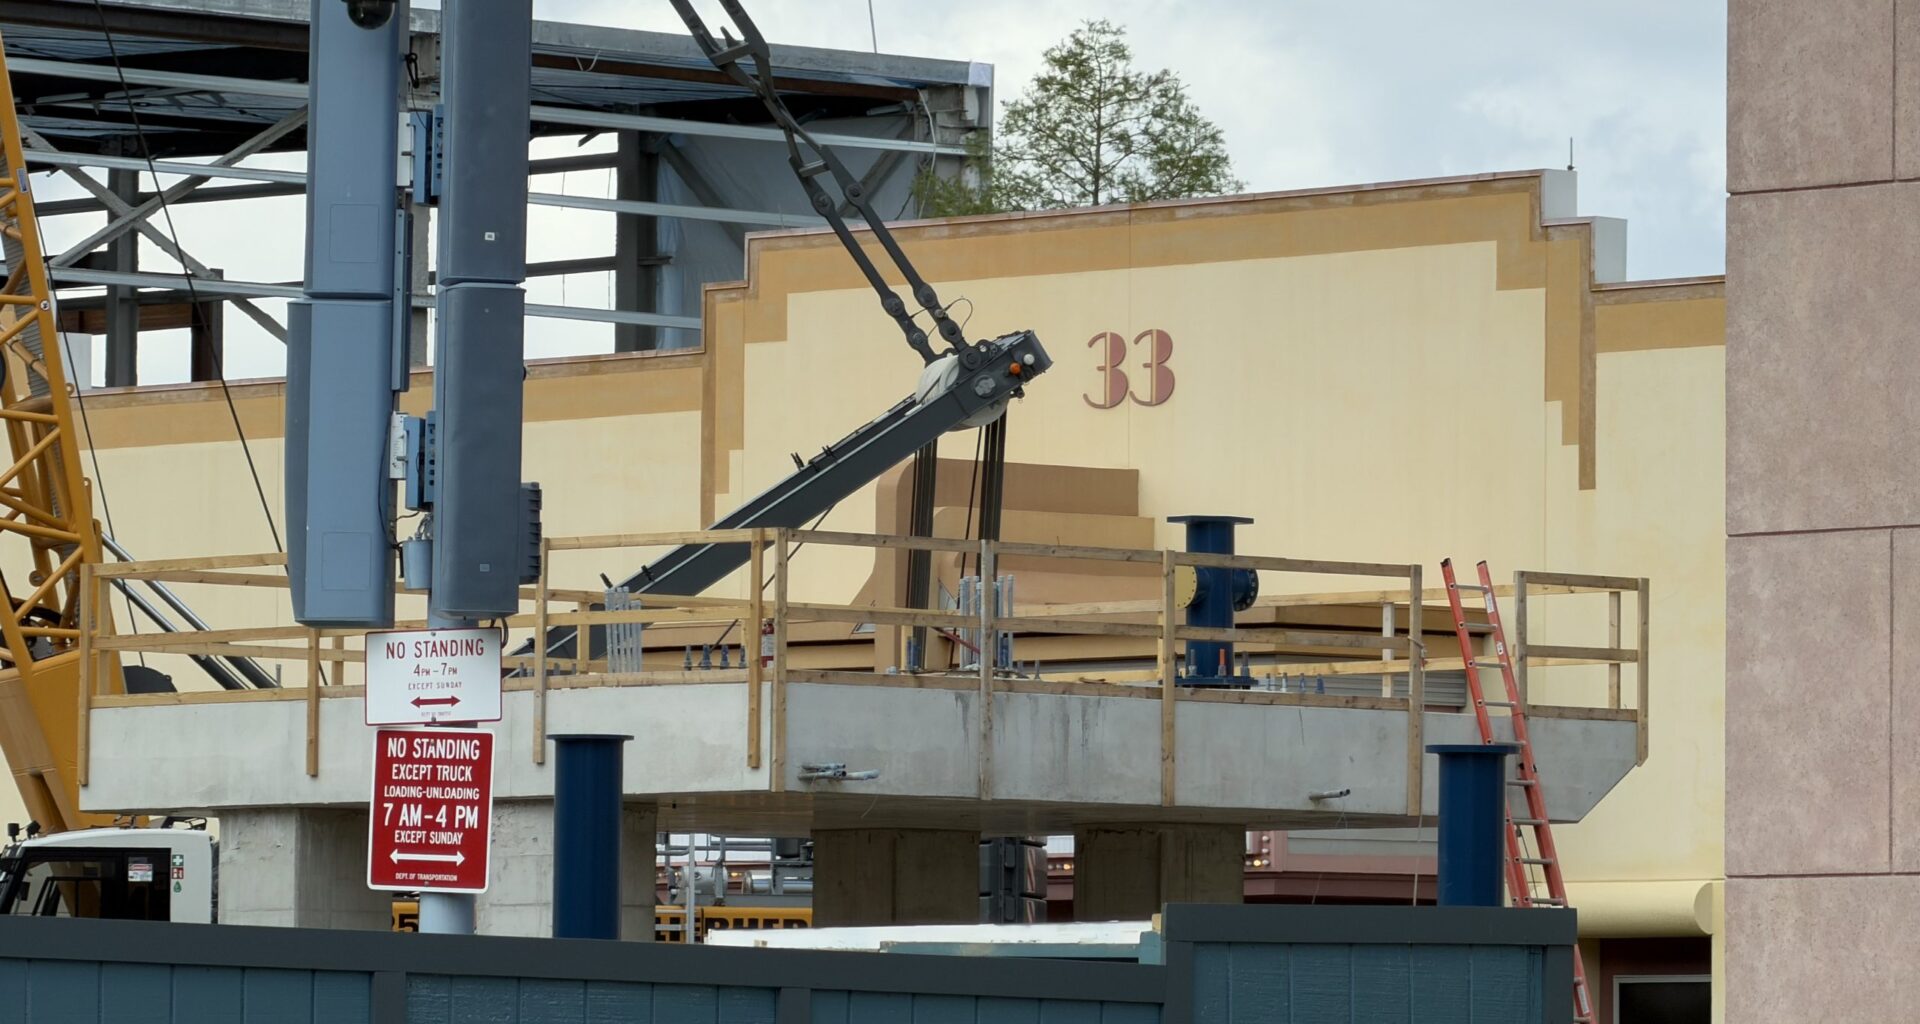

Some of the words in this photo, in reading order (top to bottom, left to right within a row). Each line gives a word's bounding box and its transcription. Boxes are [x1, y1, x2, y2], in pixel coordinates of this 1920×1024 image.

[1083, 329, 1176, 410] 33
[386, 642, 406, 659] NO
[414, 638, 484, 658] STANDING
[408, 682, 433, 690] EXCEPT
[436, 681, 462, 689] SUNDAY
[387, 737, 407, 758] NO
[412, 738, 480, 760] STANDING
[392, 764, 433, 780] EXCEPT
[436, 765, 472, 782] TRUCK
[384, 785, 480, 800] LOADING-UNLOADING
[383, 803, 394, 826] 7
[455, 805, 479, 829] PM
[394, 830, 427, 844] EXCEPT
[429, 831, 464, 845] SUNDAY
[417, 873, 458, 882] TRANSPORTATION
